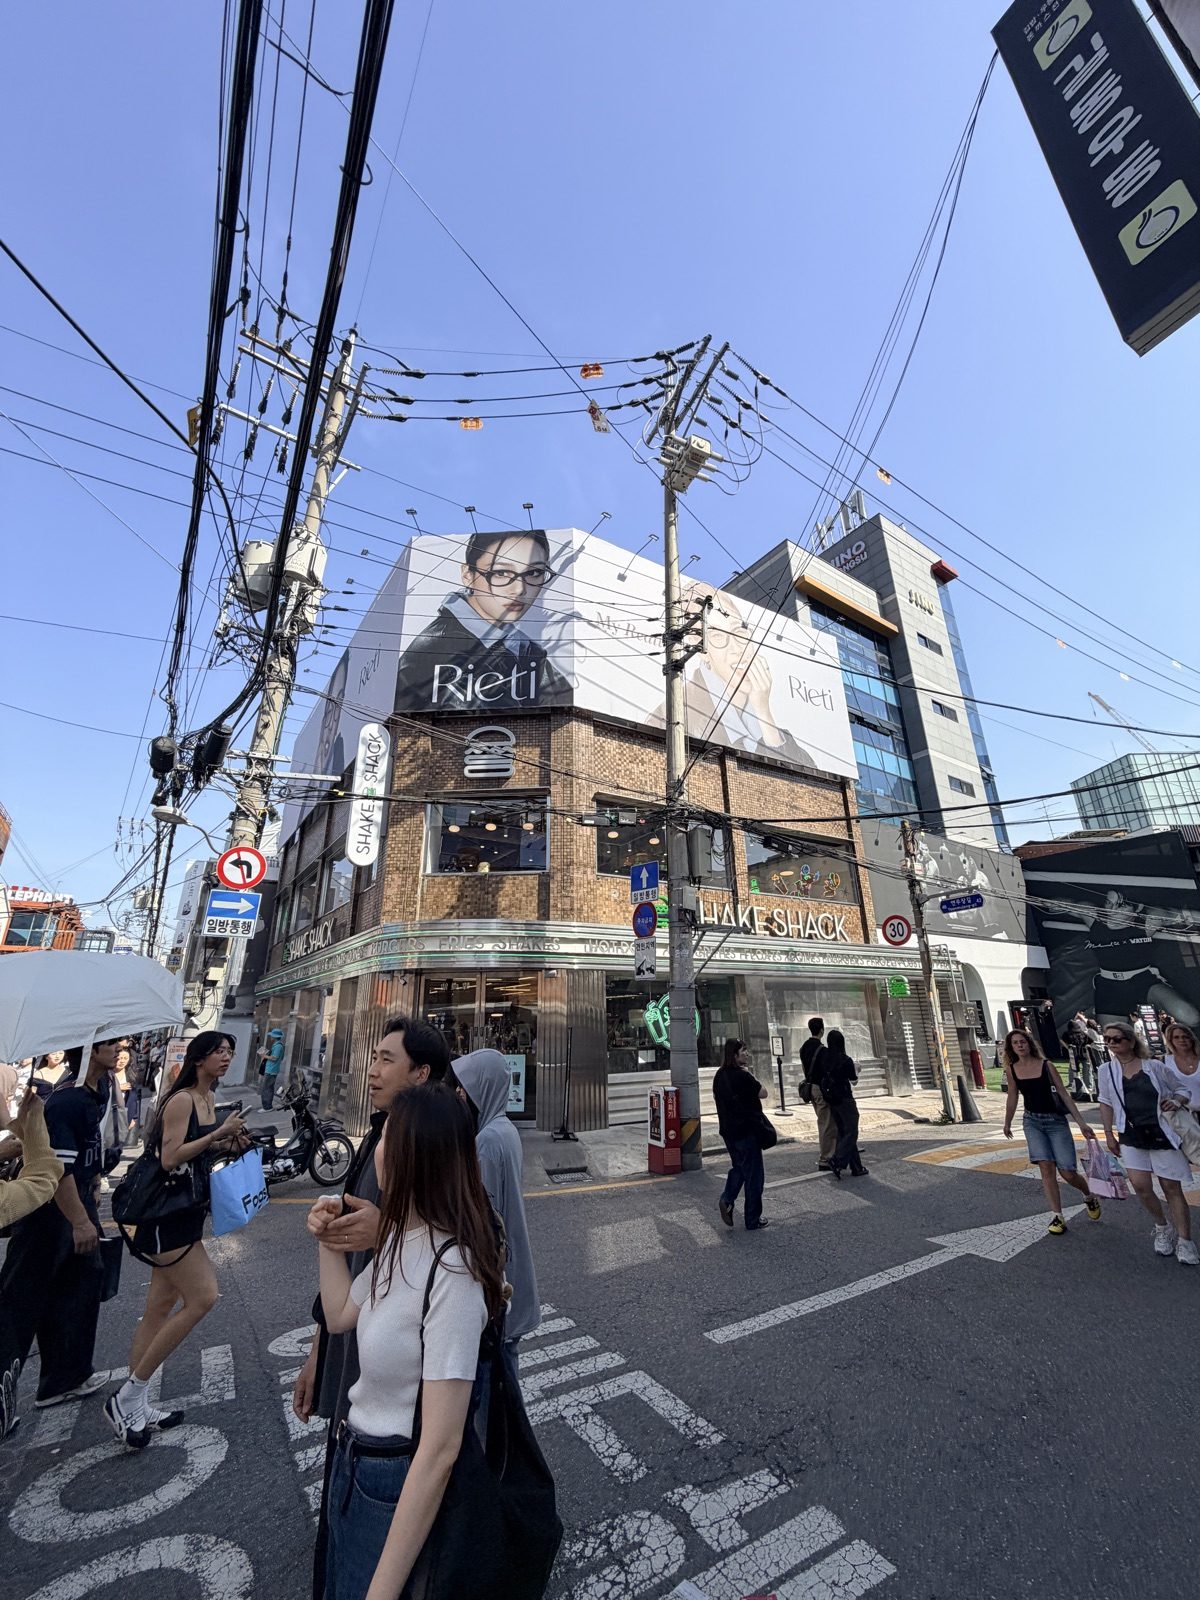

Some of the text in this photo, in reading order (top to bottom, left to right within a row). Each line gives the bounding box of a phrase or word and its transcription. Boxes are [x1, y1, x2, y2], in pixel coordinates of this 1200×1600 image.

[431, 661, 536, 703] Rieti
[789, 674, 834, 711] Rieti
[356, 732, 383, 855] SHAKE SHACK
[7, 889, 75, 904] LEPHANT
[634, 891, 657, 902] 일방통행
[206, 919, 252, 935] 일방통행
[699, 900, 850, 942] HAKE SHACK
[889, 922, 904, 938] 30
[288, 918, 335, 963] SHAKE SHACK
[371, 937, 426, 956] BURGERS
[439, 936, 484, 950] FRIES
[492, 937, 561, 951] SHAKES
[586, 938, 619, 954] HOT
[635, 941, 655, 952] 견인지역
